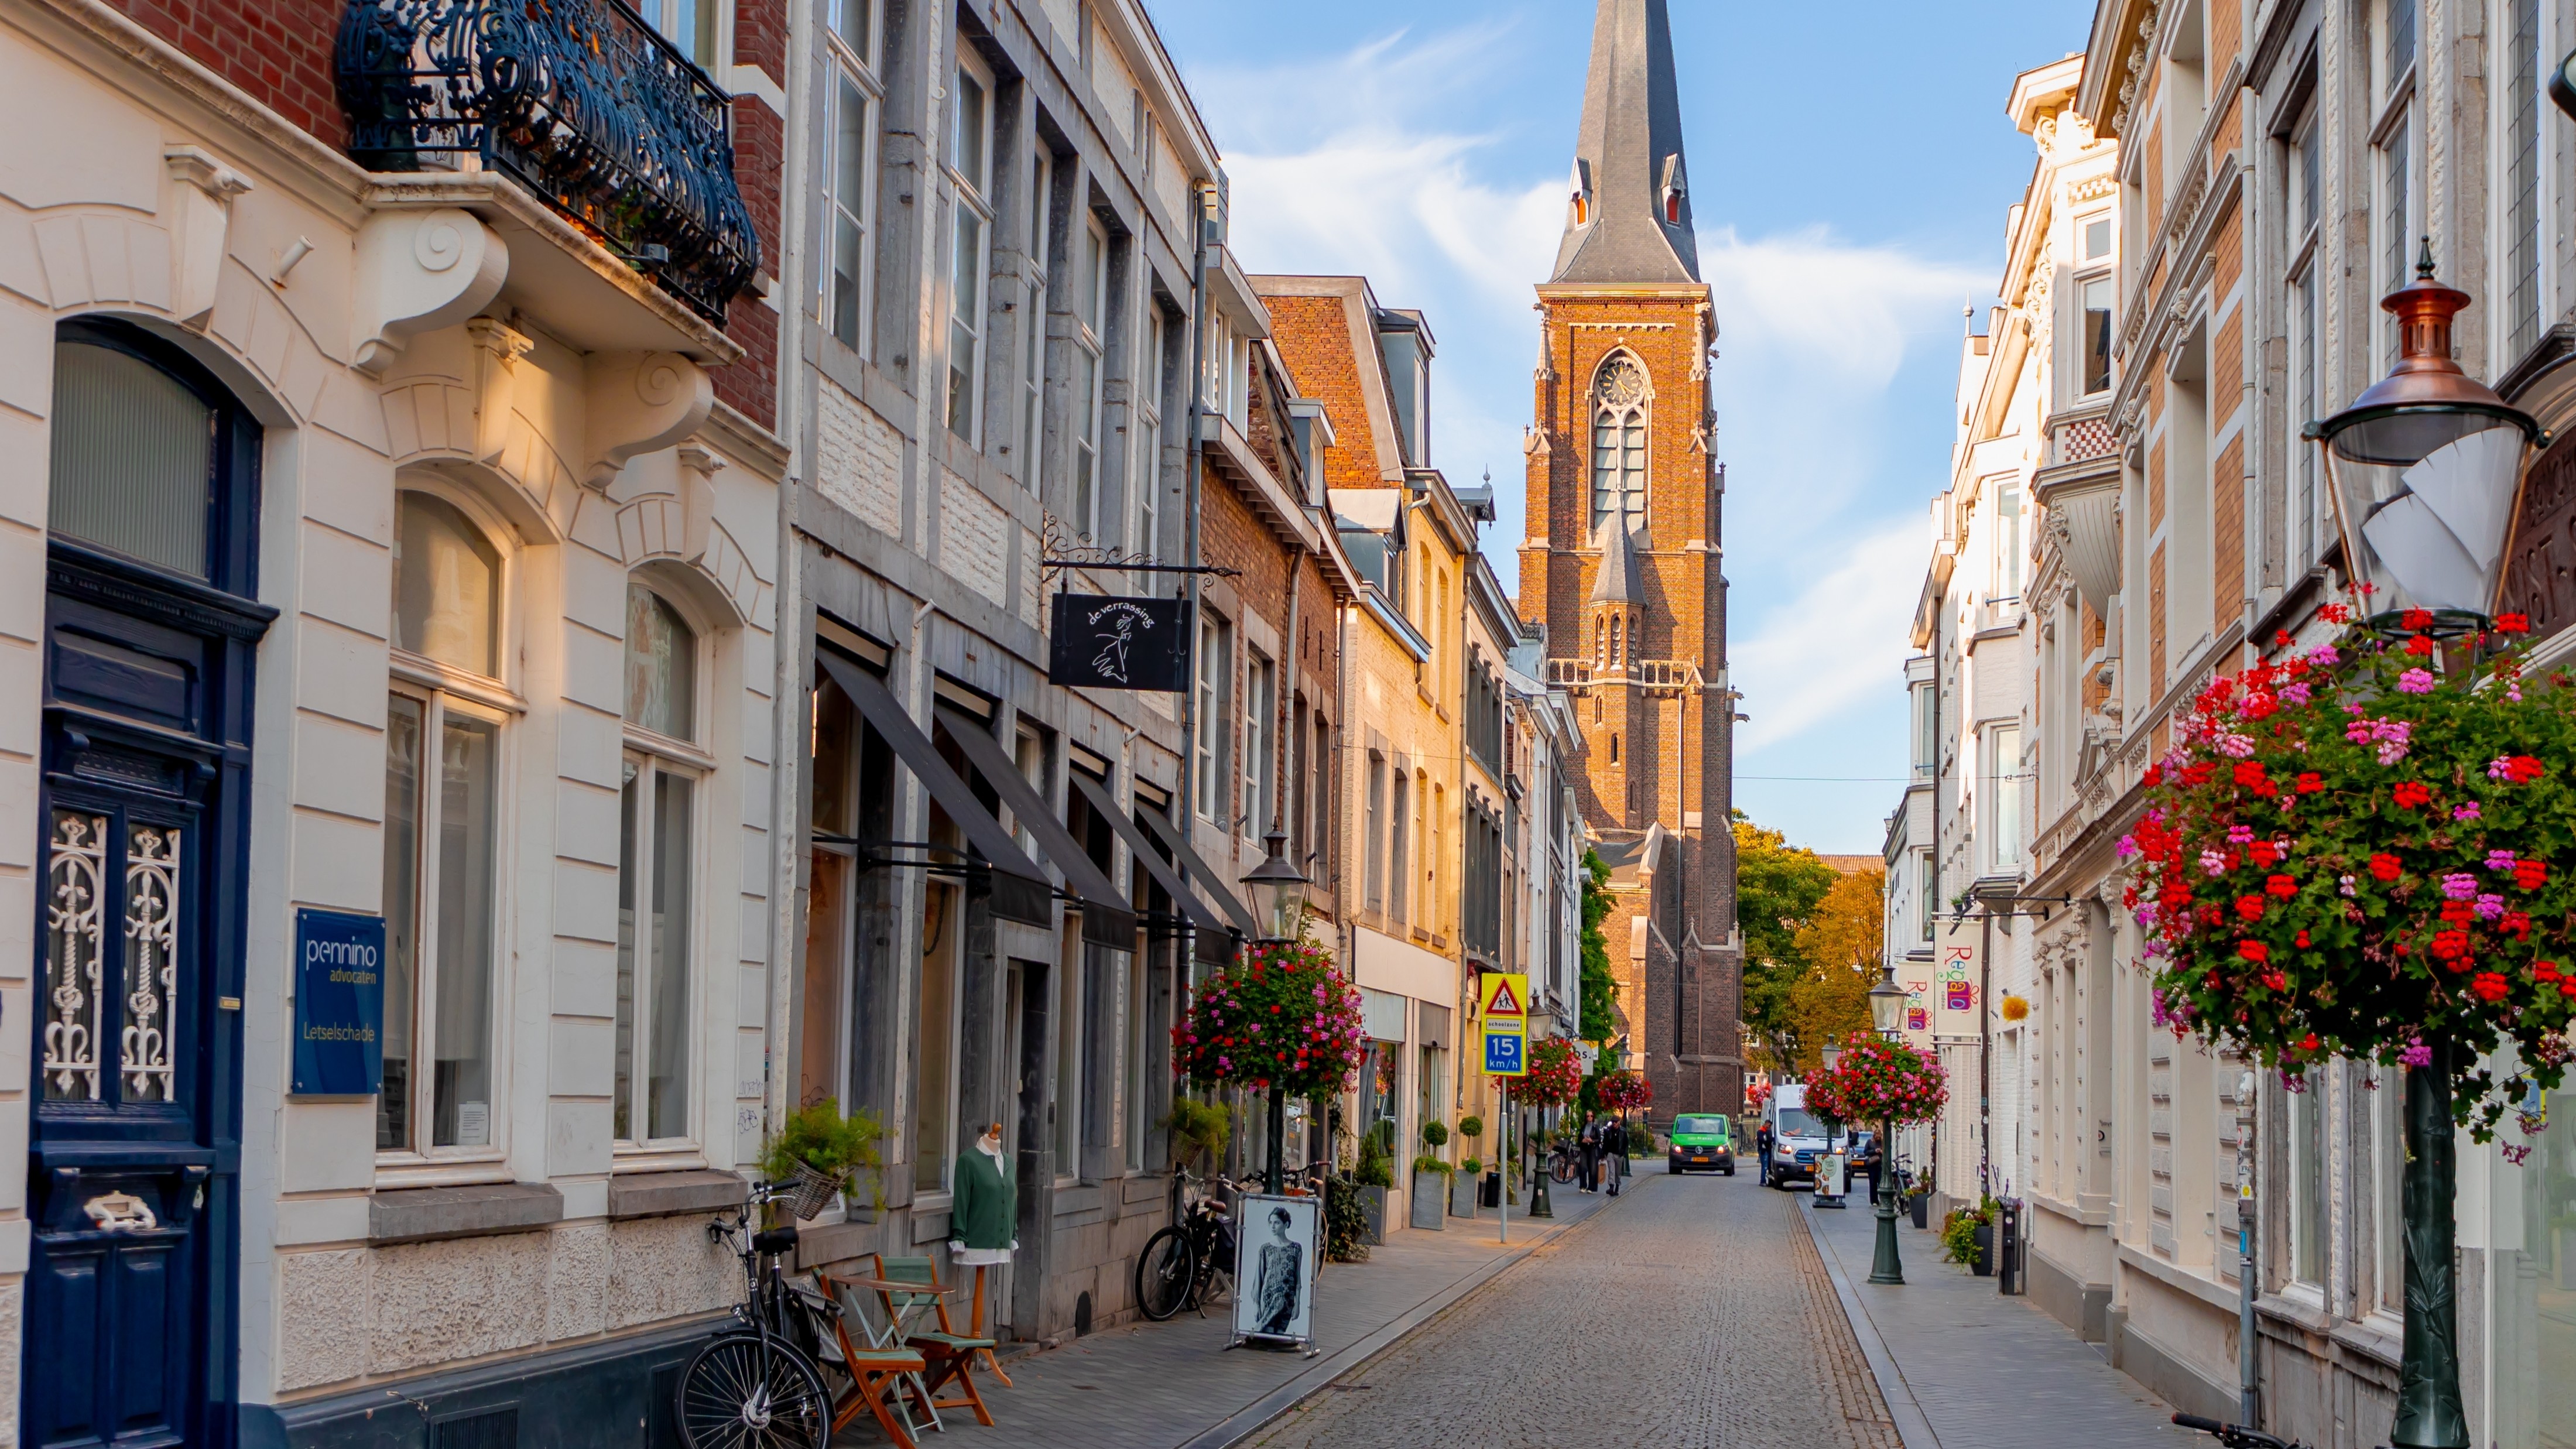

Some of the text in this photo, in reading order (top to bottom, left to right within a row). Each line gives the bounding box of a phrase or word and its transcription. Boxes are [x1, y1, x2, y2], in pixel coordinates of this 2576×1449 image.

[1088, 602, 1155, 629] de verrassing
[306, 936, 377, 971] pennino
[330, 968, 376, 985] advocaten
[1936, 945, 1972, 1010] Regalo
[303, 1021, 375, 1042] Letselschade
[1492, 1037, 1515, 1056] 15
[1489, 1059, 1518, 1070] km/h
